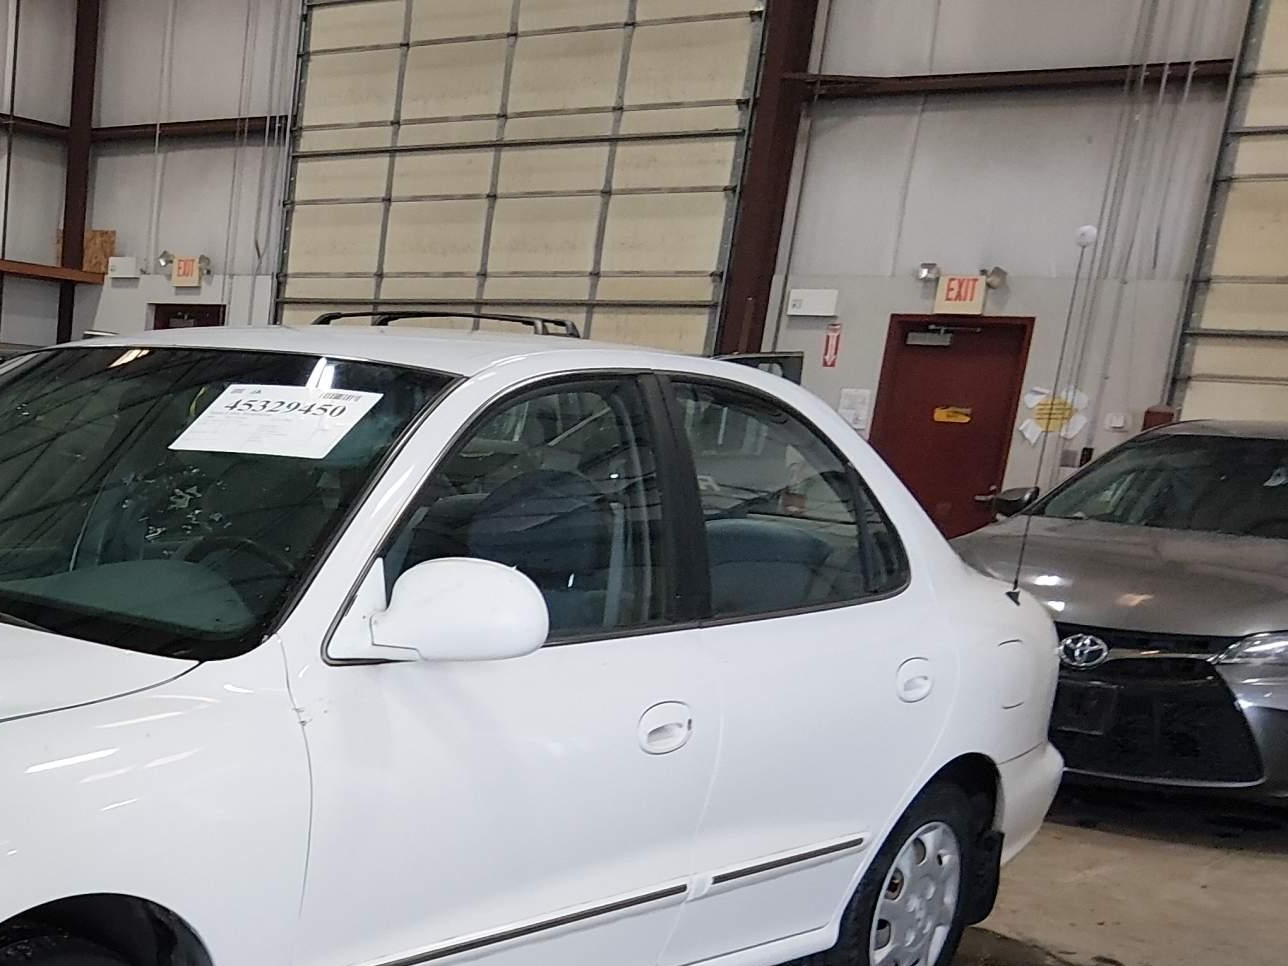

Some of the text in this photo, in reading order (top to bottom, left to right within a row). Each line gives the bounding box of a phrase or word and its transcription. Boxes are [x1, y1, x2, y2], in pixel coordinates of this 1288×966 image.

[177, 259, 196, 278] EXIT
[944, 277, 979, 302] EXIT
[224, 399, 347, 418] 45329450
